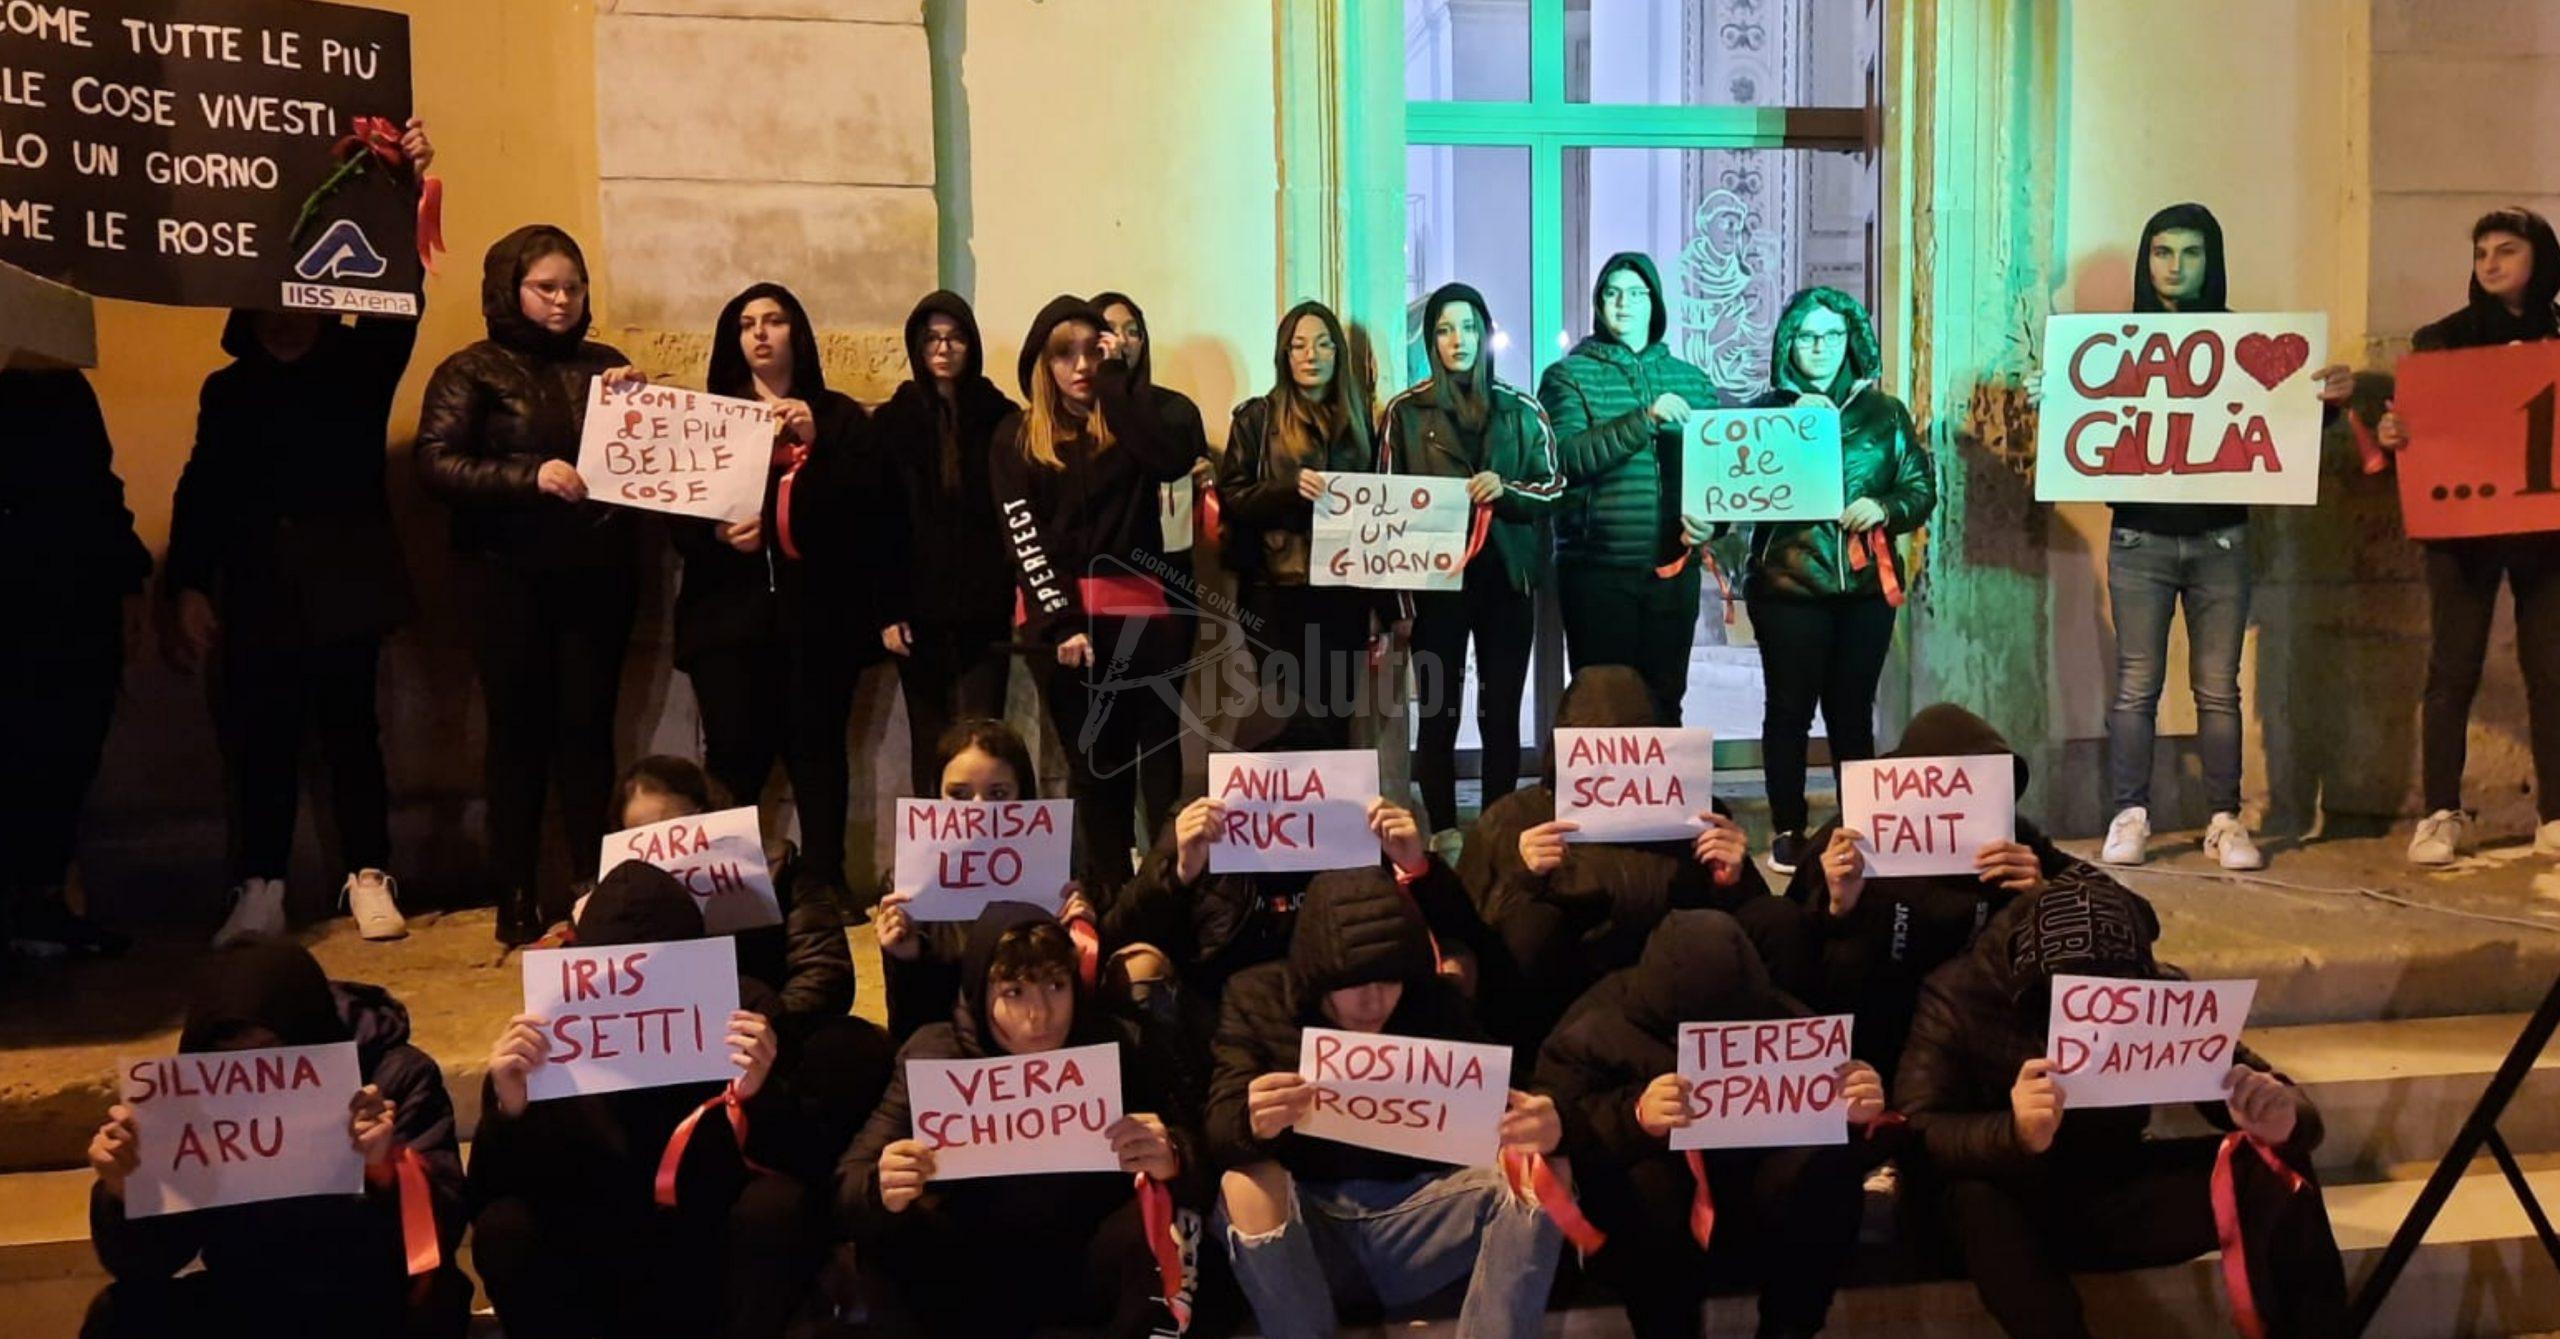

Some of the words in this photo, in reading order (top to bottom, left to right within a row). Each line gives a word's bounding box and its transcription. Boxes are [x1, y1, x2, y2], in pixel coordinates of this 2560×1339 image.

[122, 19, 242, 62] TUTTE
[263, 29, 302, 69] LE
[322, 39, 381, 80] PIÙ
[0, 67, 46, 107] LE
[72, 76, 176, 126] COSE
[199, 93, 337, 137] VIVESTI
[73, 140, 118, 177] UN
[146, 151, 279, 189] GIORNO
[0, 199, 54, 241] ME
[86, 210, 127, 250] LE
[158, 219, 259, 258] ROSE
[289, 285, 336, 306] IISS
[341, 290, 412, 313] Arena
[626, 381, 696, 411] COME
[604, 441, 733, 476] BELLE
[621, 480, 708, 502] COSE
[1327, 475, 1431, 517] SOLO
[1003, 498, 1061, 601] PERFECT
[1361, 520, 1407, 544] UN
[1329, 548, 1452, 576] GIORNO
[1568, 735, 1665, 768] ANNA
[1221, 765, 1326, 803] ANILA
[1571, 775, 1685, 808] SCALA
[1873, 765, 1973, 801] MARA
[908, 803, 1054, 842] MARISA
[1224, 810, 1315, 849] RUCI
[1872, 813, 1964, 855] FAIT
[627, 825, 709, 863] SARA
[670, 861, 746, 897] CHI
[939, 847, 1023, 889] LEO
[562, 952, 648, 1003] IRIS
[2062, 984, 2218, 1027] COSIMA
[548, 1004, 703, 1063] SETTI
[1687, 1019, 1847, 1071] TERESA
[2057, 1031, 2228, 1075] D'AMATO
[128, 1055, 321, 1103] SILVANA
[946, 1059, 1084, 1106] VERA
[1315, 1035, 1483, 1090] ROSINA
[918, 1097, 1107, 1151] SCHIOPU
[1314, 1087, 1446, 1132] ROSSI
[173, 1116, 284, 1171] ARU
